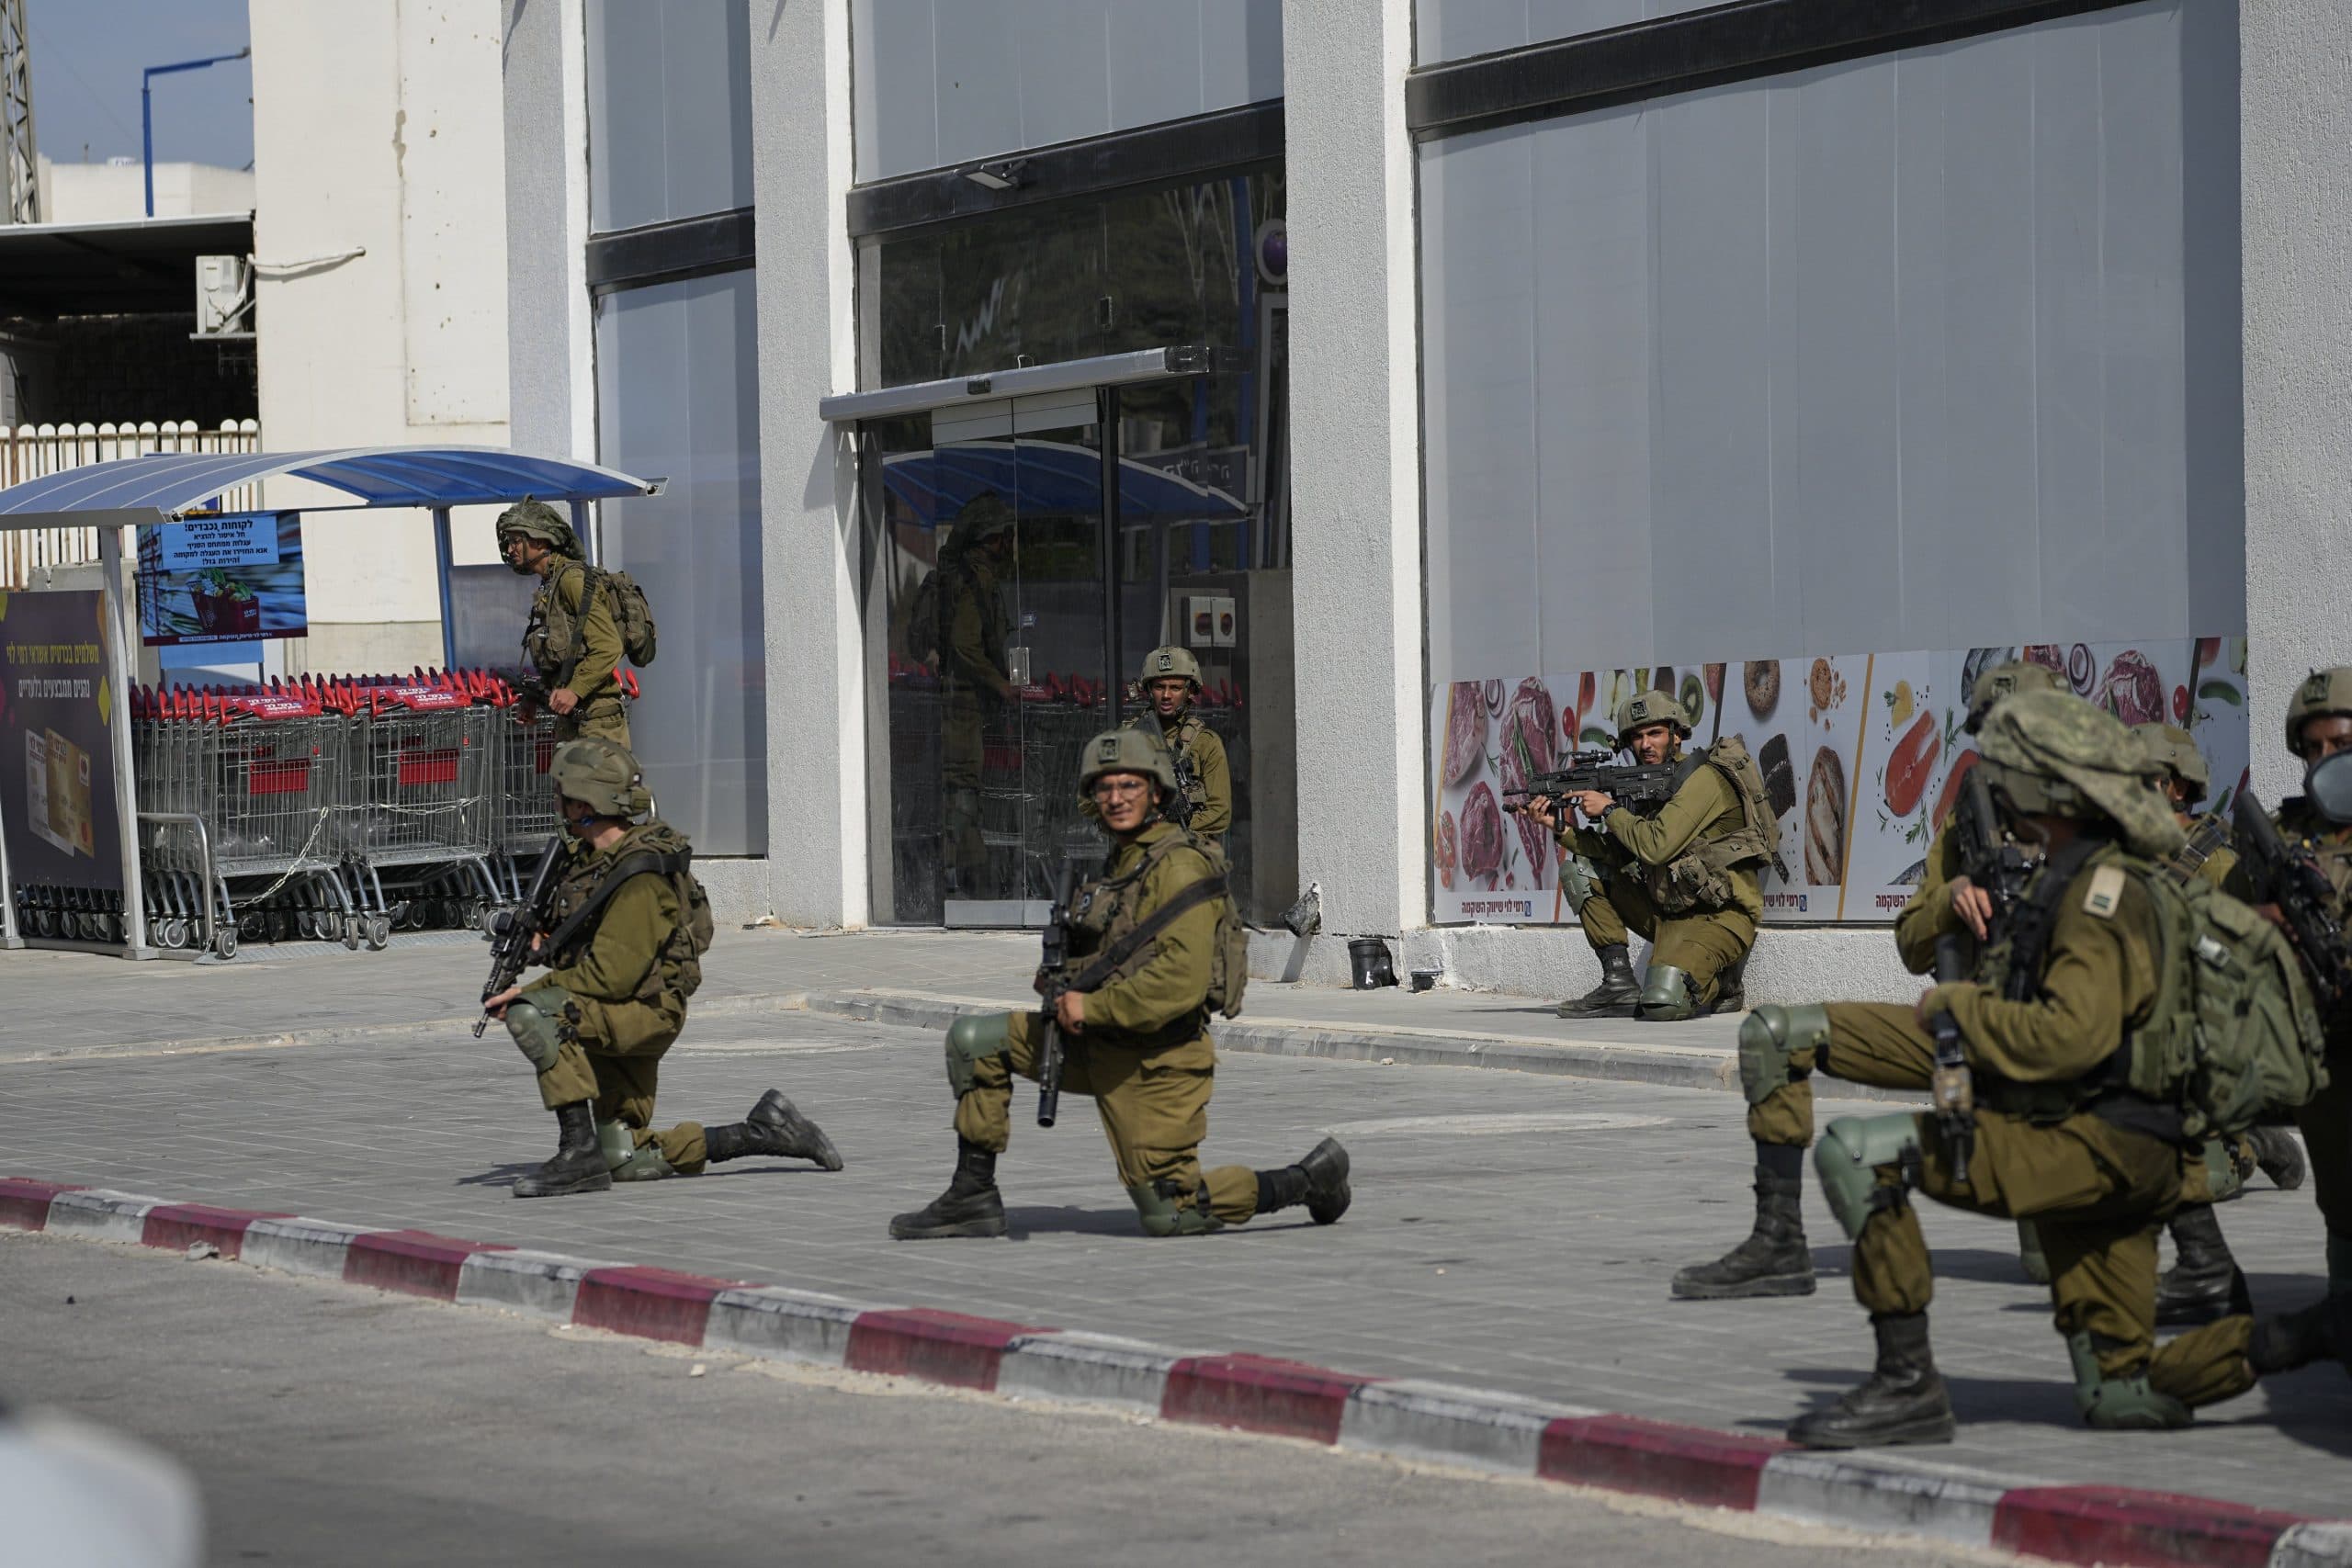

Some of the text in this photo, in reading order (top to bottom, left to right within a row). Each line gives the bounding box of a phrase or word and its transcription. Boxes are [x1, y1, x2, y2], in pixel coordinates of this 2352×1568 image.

[185, 520, 253, 532] לקוחות נכבדים!
[194, 533, 215, 541] להוציא
[217, 532, 234, 540] איסור
[6, 641, 16, 664] לוי
[17, 646, 28, 664] רמי
[29, 645, 49, 664] אשראי
[51, 645, 73, 664] בכרטיס
[18, 675, 42, 698] בלעדיים
[74, 679, 90, 698] נהנים
[1462, 898, 1524, 918] רמי לוי שיווק השקמה
[1776, 892, 1785, 908] לוי
[1787, 895, 1798, 908] רמי
[1876, 895, 1905, 912] השקמה
